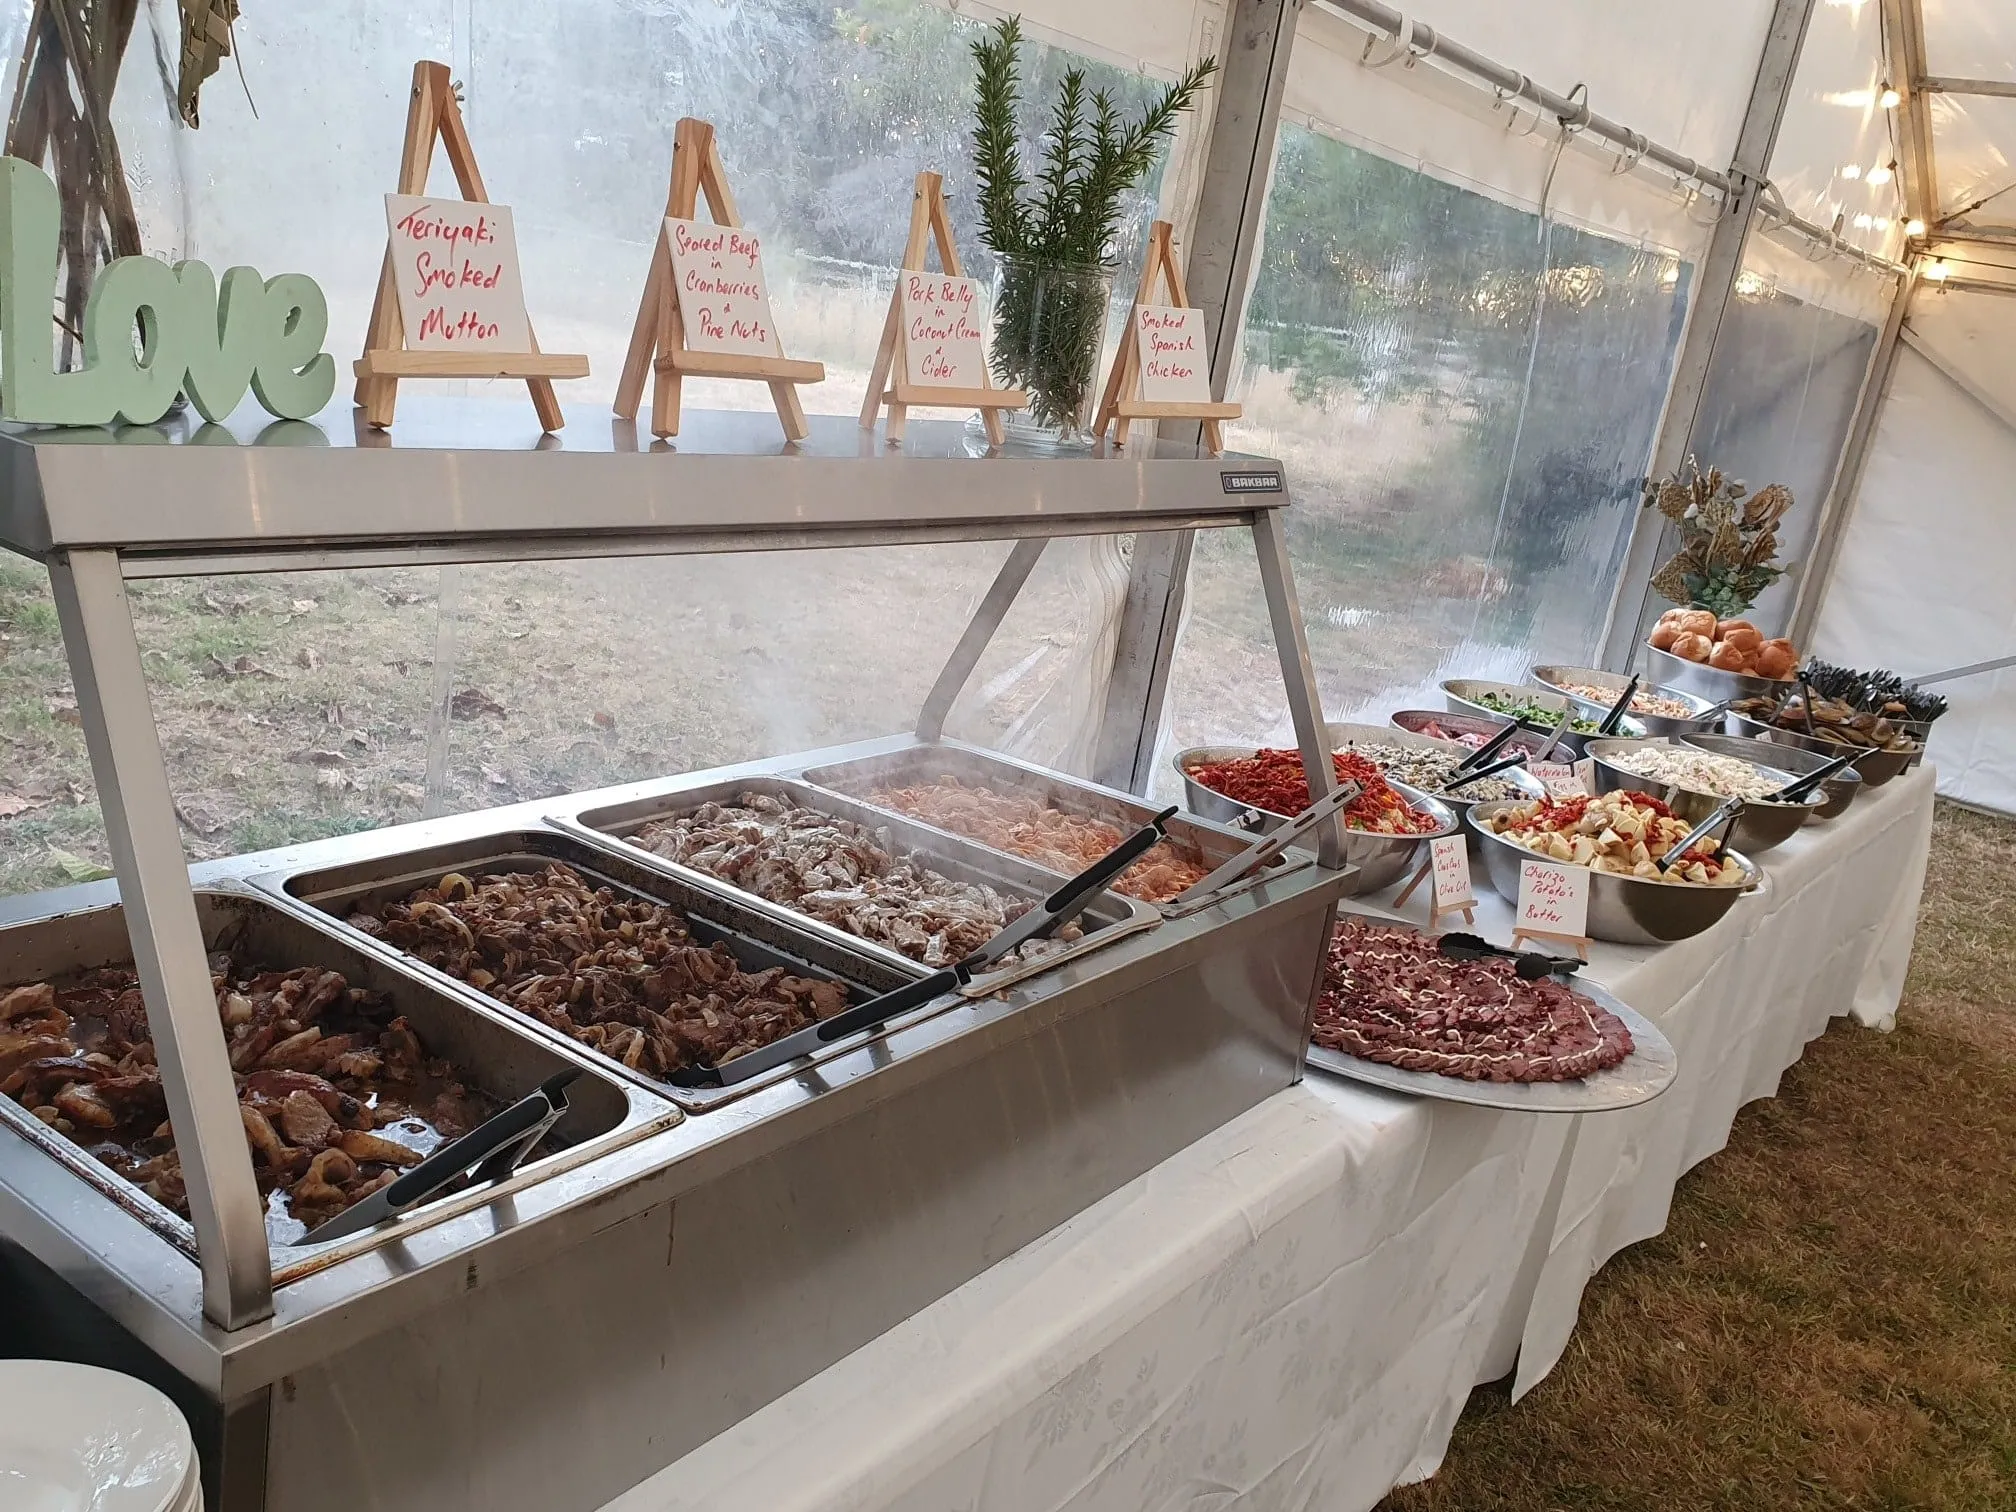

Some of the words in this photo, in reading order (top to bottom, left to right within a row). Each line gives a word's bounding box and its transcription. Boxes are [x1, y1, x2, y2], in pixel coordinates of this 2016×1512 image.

[397, 205, 496, 267] Teriyaki
[676, 224, 724, 256] Seared
[729, 234, 759, 269] Beef
[415, 251, 501, 298] Smoked
[711, 256, 722, 269] in
[0, 156, 336, 425] Love
[686, 269, 759, 300] Cranberries
[908, 276, 934, 304] Pork
[941, 282, 973, 313] Belly
[419, 306, 499, 341] Mutton
[935, 305, 945, 318] in
[1141, 310, 1185, 330] Smoked
[698, 307, 724, 339] Pine
[730, 319, 765, 342] Nuts
[911, 316, 953, 341] Coconut
[955, 316, 981, 340] Cream
[1150, 332, 1194, 357] Spanish
[921, 354, 958, 378] Cider
[1146, 360, 1193, 378] Chicken
[1231, 477, 1278, 488] BAKBAR
[1525, 904, 1563, 922] Butter
[1546, 896, 1557, 905] in
